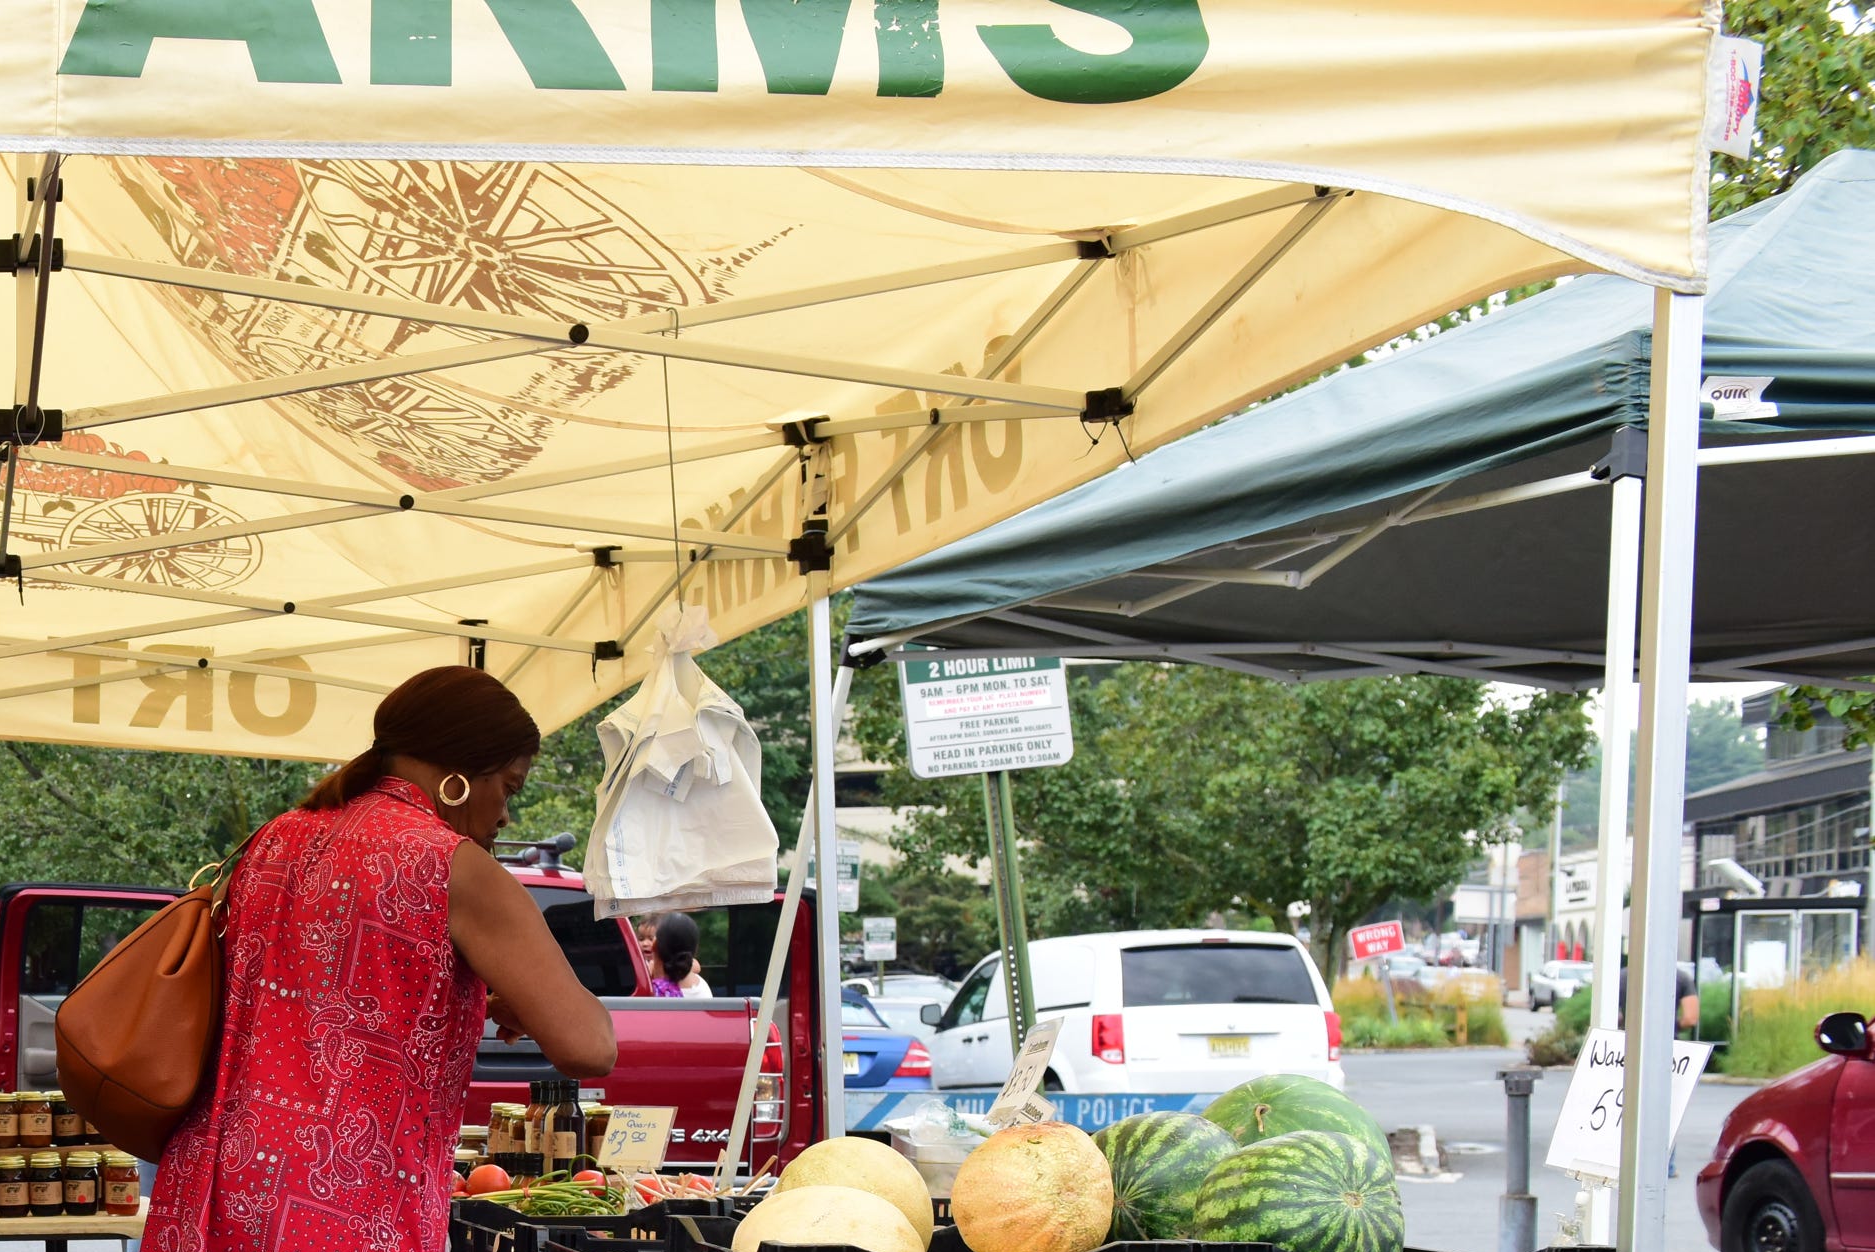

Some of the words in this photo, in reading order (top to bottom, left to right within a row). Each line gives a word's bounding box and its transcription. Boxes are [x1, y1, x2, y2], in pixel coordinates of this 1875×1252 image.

[1711, 389, 1749, 400] QUIK
[929, 662, 940, 678] 2
[944, 658, 989, 676] HOUR
[993, 656, 1036, 671] LIMIT
[920, 687, 943, 698] 9AM
[956, 683, 979, 694] 6PM
[983, 680, 1010, 691] MON.
[1015, 678, 1027, 689] TO
[1031, 676, 1051, 688] SAT.
[930, 734, 947, 742] AFTER
[983, 728, 1008, 737] SUNDAYS
[1011, 726, 1022, 734] AND
[1024, 723, 1052, 732] HOLIDAYS
[960, 719, 980, 729] FREE
[984, 716, 1020, 727] PARKING
[933, 747, 961, 760] HEAD
[965, 746, 975, 757] IN
[979, 742, 1023, 756] PARKING
[1027, 739, 1052, 751] ONLY
[928, 765, 939, 773] NO
[943, 760, 978, 772] PARKING
[981, 756, 1012, 767] 2:30AM
[1016, 755, 1026, 764] TO
[1029, 752, 1060, 763] 5:30AM
[1356, 927, 1396, 943] WRONG
[1365, 940, 1389, 954] WAY
[1078, 1098, 1156, 1126] POLICE
